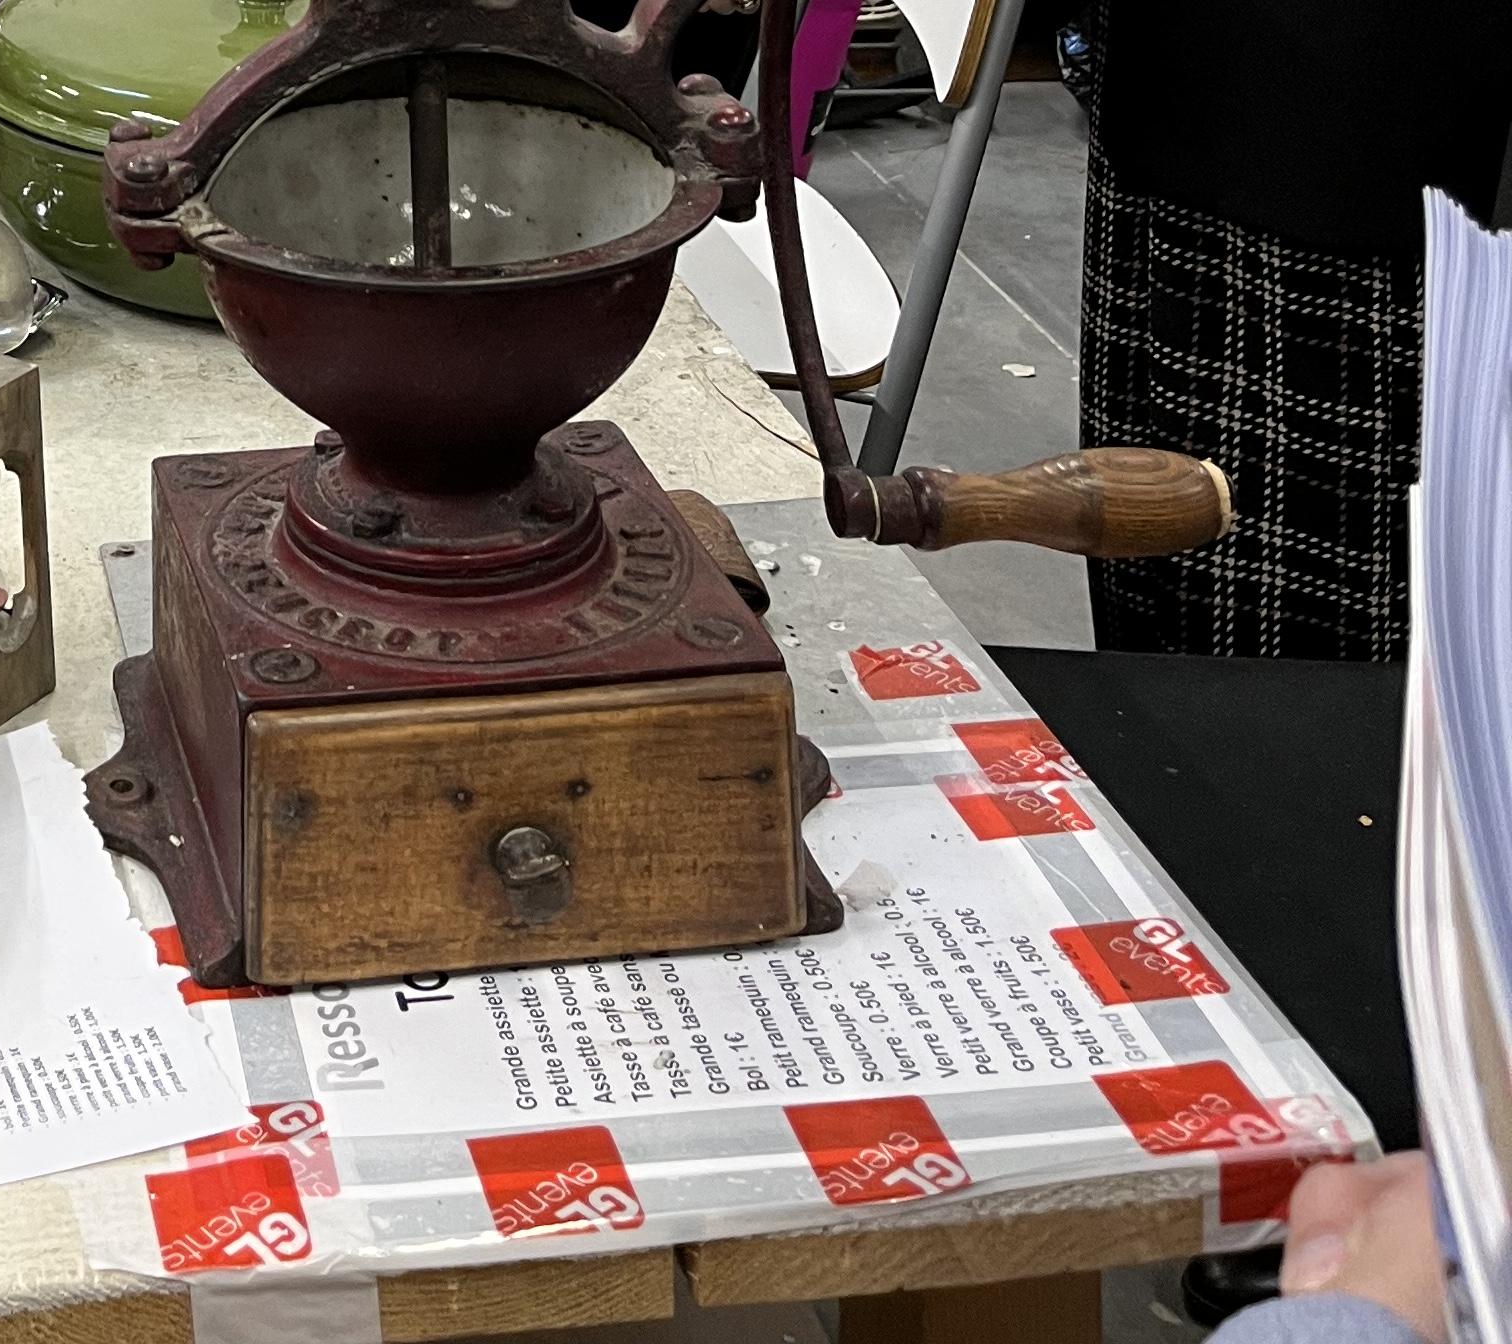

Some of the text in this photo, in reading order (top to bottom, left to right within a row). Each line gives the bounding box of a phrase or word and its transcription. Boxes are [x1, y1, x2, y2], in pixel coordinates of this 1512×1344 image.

[1004, 790, 1090, 832] vents
[894, 932, 939, 976] alcool
[1108, 936, 1225, 996] events
[1133, 917, 1193, 963] GL
[905, 887, 1035, 1072] Grand verre à alcool 1€
[926, 980, 947, 989] à
[954, 907, 1073, 1069] Coupe à fruits 1.50€
[1009, 935, 1111, 1066] Petit vase 1.50€
[548, 965, 617, 1104] Assiette à soupe
[594, 997, 626, 1034] café
[631, 996, 663, 1031] café
[648, 1035, 670, 1046] à
[658, 963, 731, 1095] Grande tasse ou
[737, 974, 809, 1088] Petit ramequin
[768, 959, 845, 1085] Grand ramequin
[794, 948, 884, 1083] Soucoupe 0.50€
[849, 980, 921, 1081] Verre 0.50€
[870, 951, 959, 1079] Verre à pied 1€
[938, 993, 973, 1034] verre
[1098, 1012, 1150, 1063] Grand
[474, 975, 538, 1110] Grande assiette
[519, 986, 578, 1108] Petite assiette
[611, 1037, 633, 1047] à
[723, 1031, 770, 1091] Bol 1€
[960, 1037, 999, 1075] Petit
[621, 1051, 654, 1103] Tasse
[268, 1102, 318, 1158] GL
[882, 1153, 967, 1196] GL
[160, 1191, 271, 1269] events
[554, 1186, 641, 1232] GL
[223, 1212, 309, 1266] GL
